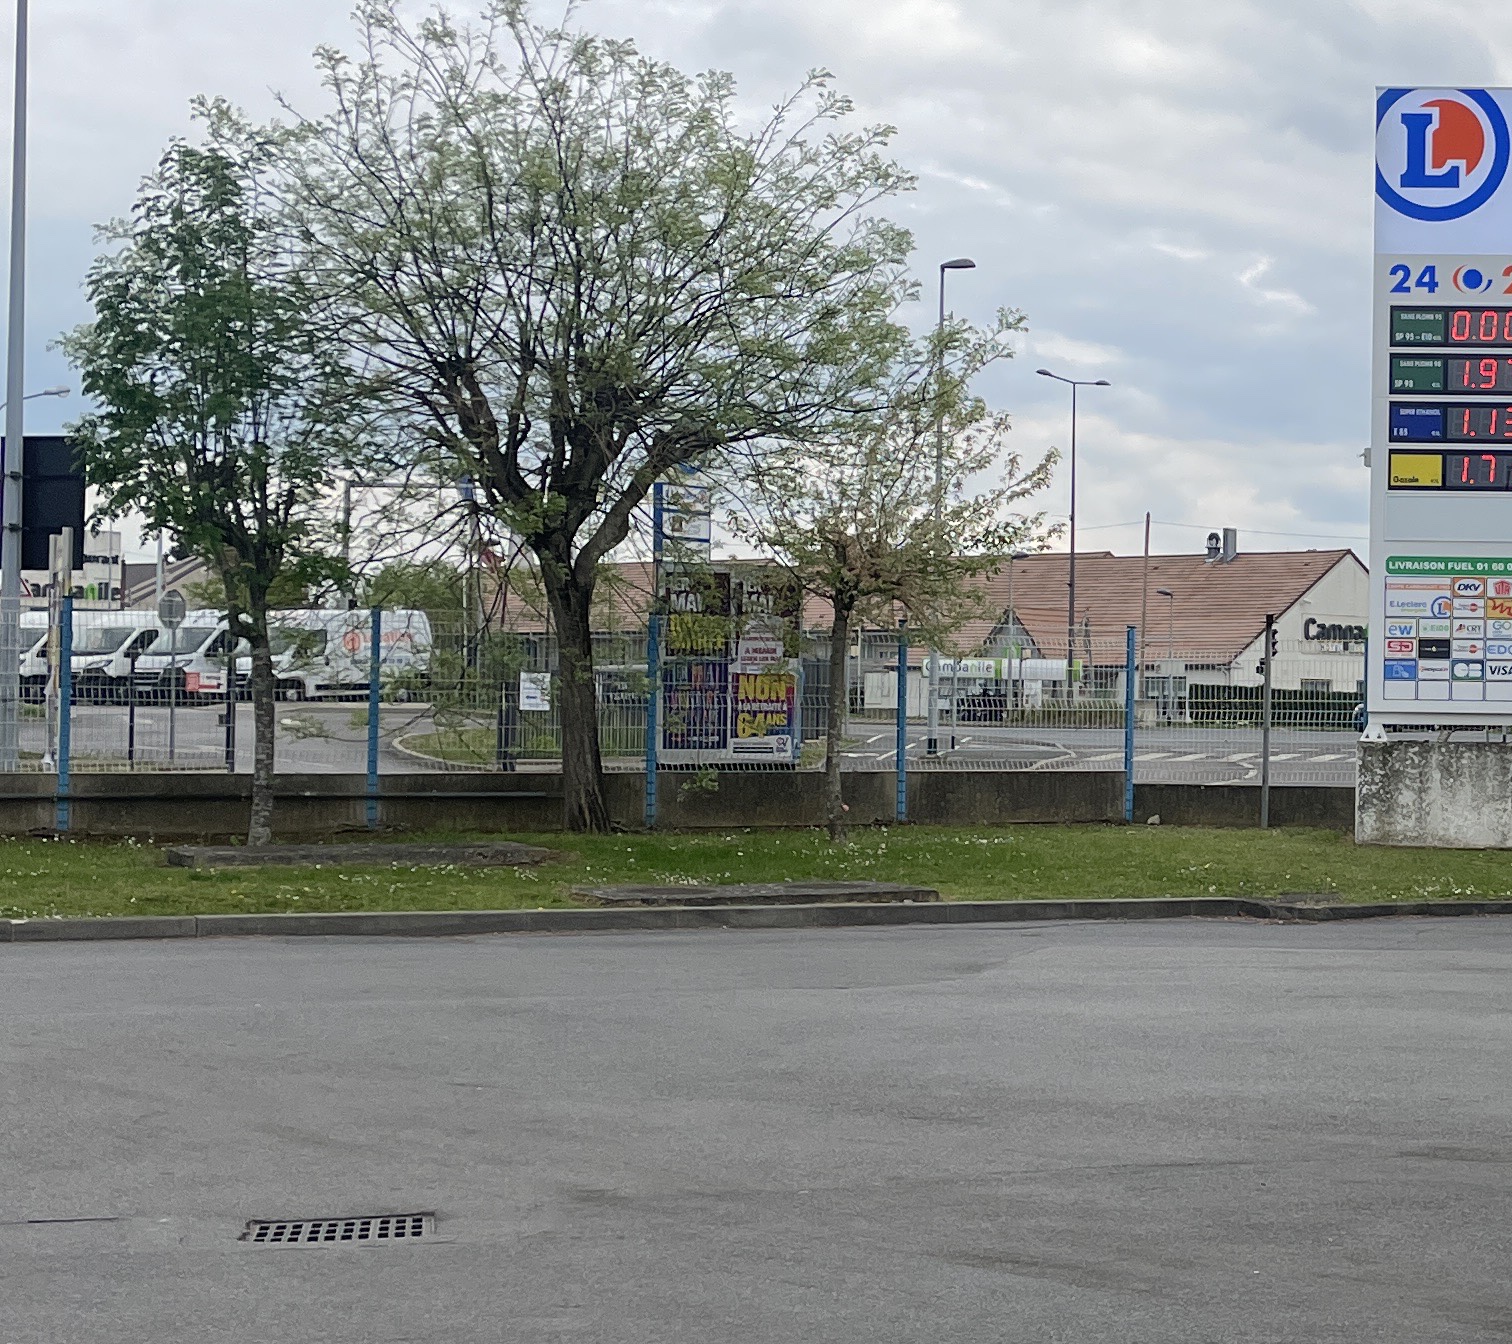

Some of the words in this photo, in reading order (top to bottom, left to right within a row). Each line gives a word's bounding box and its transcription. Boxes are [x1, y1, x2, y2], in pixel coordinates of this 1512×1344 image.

[1400, 113, 1459, 188] L
[1389, 264, 1439, 293] 24
[1405, 332, 1414, 340] 95
[1388, 561, 1445, 571] LIVRAISON
[1448, 562, 1474, 571] FUEL
[1477, 562, 1488, 571] 01
[1457, 583, 1481, 591] DKV
[738, 674, 787, 701] NON
